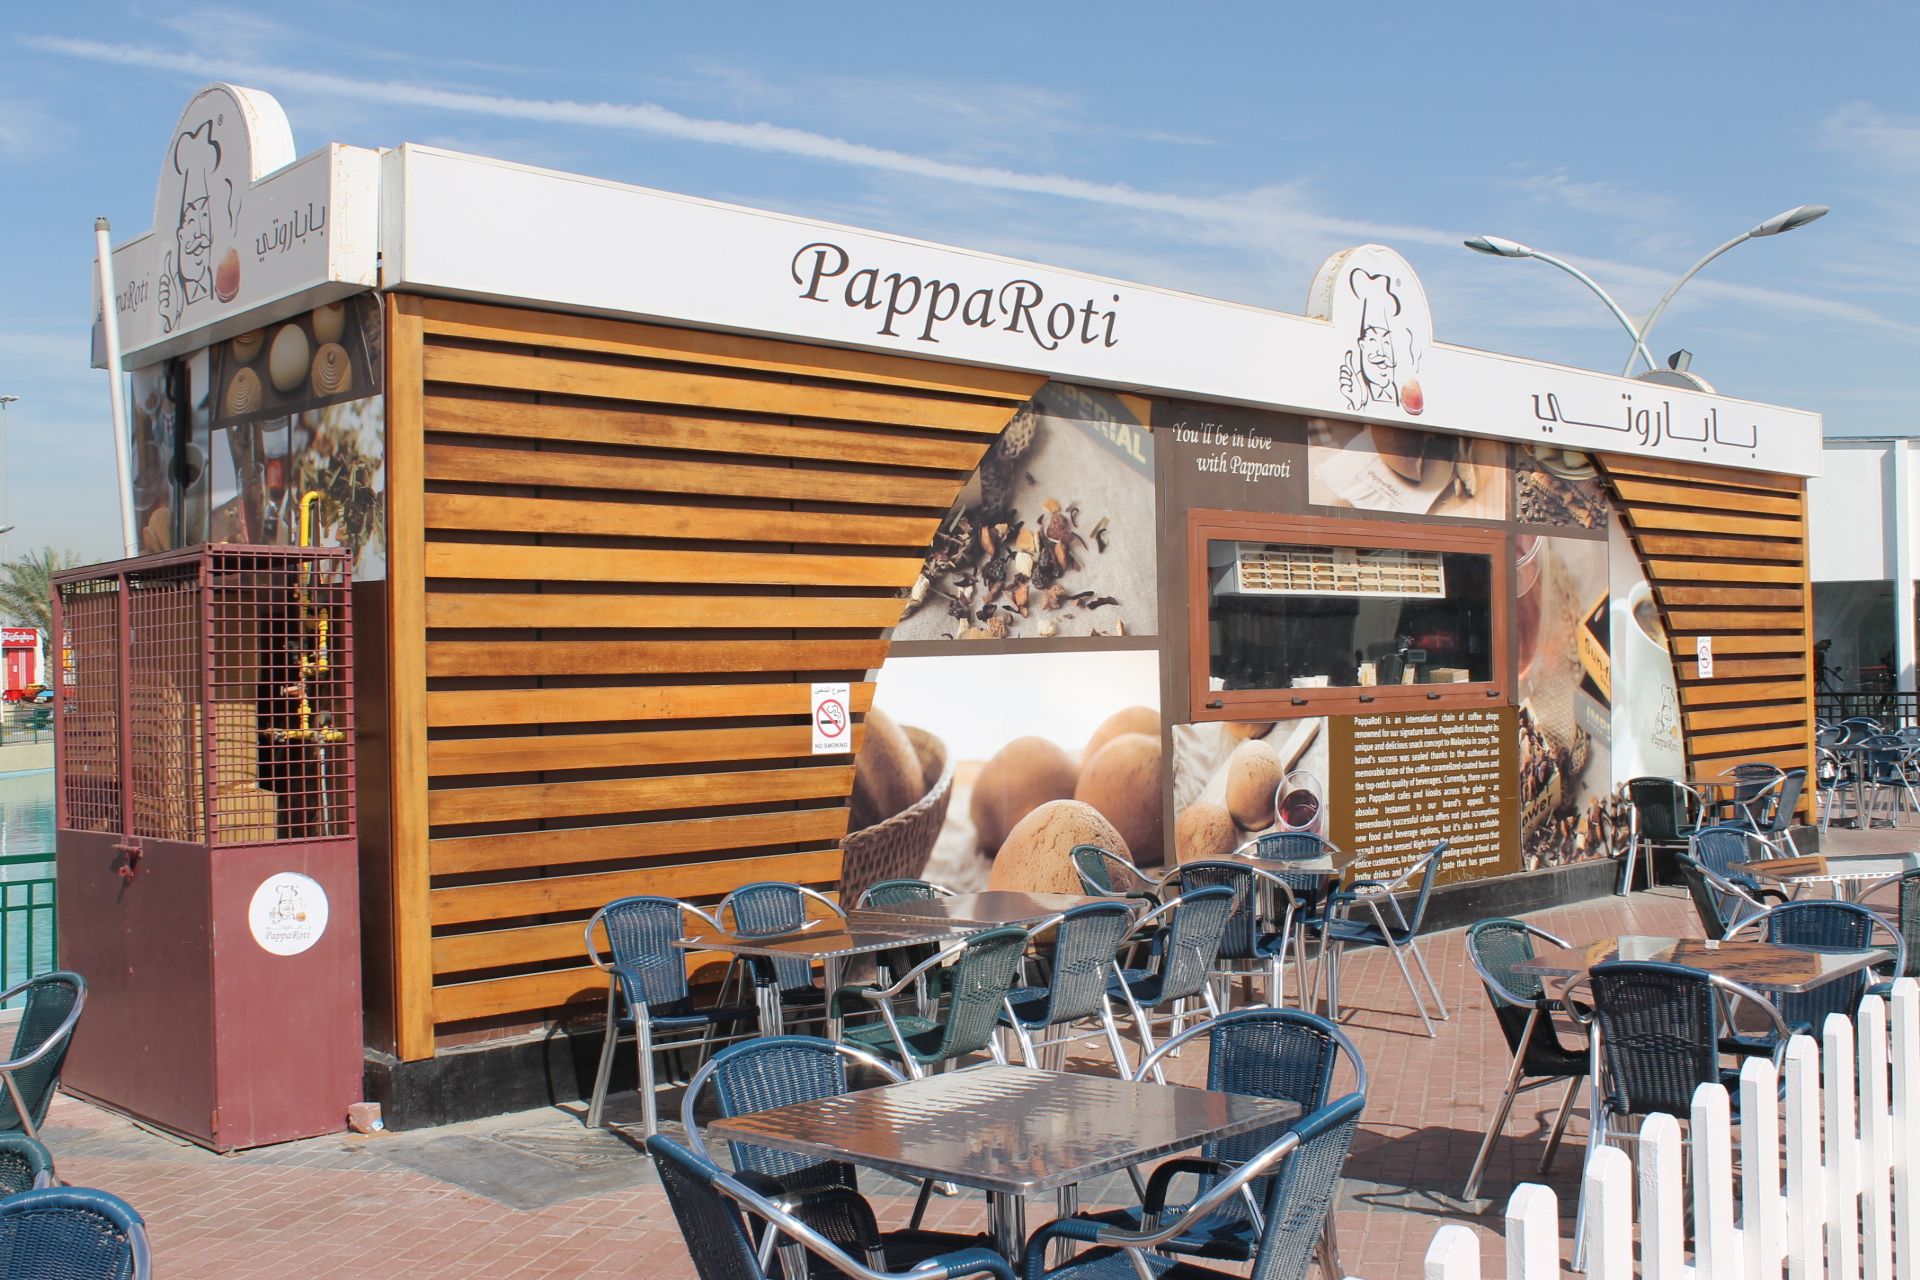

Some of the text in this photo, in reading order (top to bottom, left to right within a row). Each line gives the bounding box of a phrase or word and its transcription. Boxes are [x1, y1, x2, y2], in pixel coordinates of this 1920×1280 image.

[791, 242, 1120, 351] PappaRoti
[1172, 422, 1272, 450] You'll be in love
[1196, 452, 1291, 482] with Papparoti
[1386, 716, 1390, 724] is
[1405, 714, 1437, 724] international
[1442, 712, 1455, 721] chain
[1459, 712, 1464, 721] of
[1468, 712, 1482, 720] coffee
[1486, 712, 1500, 722] shops
[1355, 729, 1381, 738] renowned
[1400, 728, 1423, 738] signature
[1464, 724, 1474, 732] first
[1475, 724, 1492, 734] brought
[1355, 743, 1373, 753] unique
[1374, 741, 1384, 750] and
[1385, 741, 1408, 750] delicious
[1409, 740, 1423, 748] snack
[1424, 739, 1443, 748] concept
[1451, 736, 1471, 746] Malaysia
[1431, 750, 1448, 759] thanks
[1450, 750, 1455, 758] to
[1457, 749, 1465, 757] the
[1467, 748, 1488, 757] authentic
[1490, 747, 1499, 755] and
[1355, 767, 1385, 778] memorable
[1386, 767, 1398, 775] taste
[1400, 766, 1405, 774] of
[1406, 766, 1414, 774] the
[1415, 764, 1430, 773] coffee
[1479, 760, 1490, 768] buns
[1490, 759, 1499, 767] and
[1355, 782, 1364, 790] the
[1391, 778, 1408, 789] quality
[1409, 778, 1415, 786] of
[1468, 773, 1480, 781] there
[1413, 789, 1423, 798] and
[1426, 788, 1441, 797] kiosks
[1462, 786, 1470, 794] the
[1472, 784, 1486, 795] globe
[1355, 808, 1378, 816] absolute
[1385, 804, 1410, 814] testament
[1355, 807, 1499, 830] tremendously successful chain offers not just scrumptious
[1369, 832, 1381, 841] food
[1383, 830, 1393, 840] and
[1395, 830, 1418, 839] beverage
[1443, 824, 1451, 832] but
[1462, 822, 1473, 830] also
[1383, 844, 1392, 852] the
[1413, 839, 1427, 850] Right
[1427, 838, 1439, 847] from
[1449, 834, 1474, 844] distinctive
[1475, 833, 1489, 841] aroma
[1490, 830, 1499, 839] that
[1355, 859, 1371, 869] entice
[1407, 853, 1416, 862] the
[1491, 842, 1500, 851] and
[1392, 867, 1402, 877] and
[1443, 861, 1456, 870] taste
[1456, 859, 1467, 868] that
[1468, 858, 1477, 866] has
[1479, 854, 1500, 866] garnered
